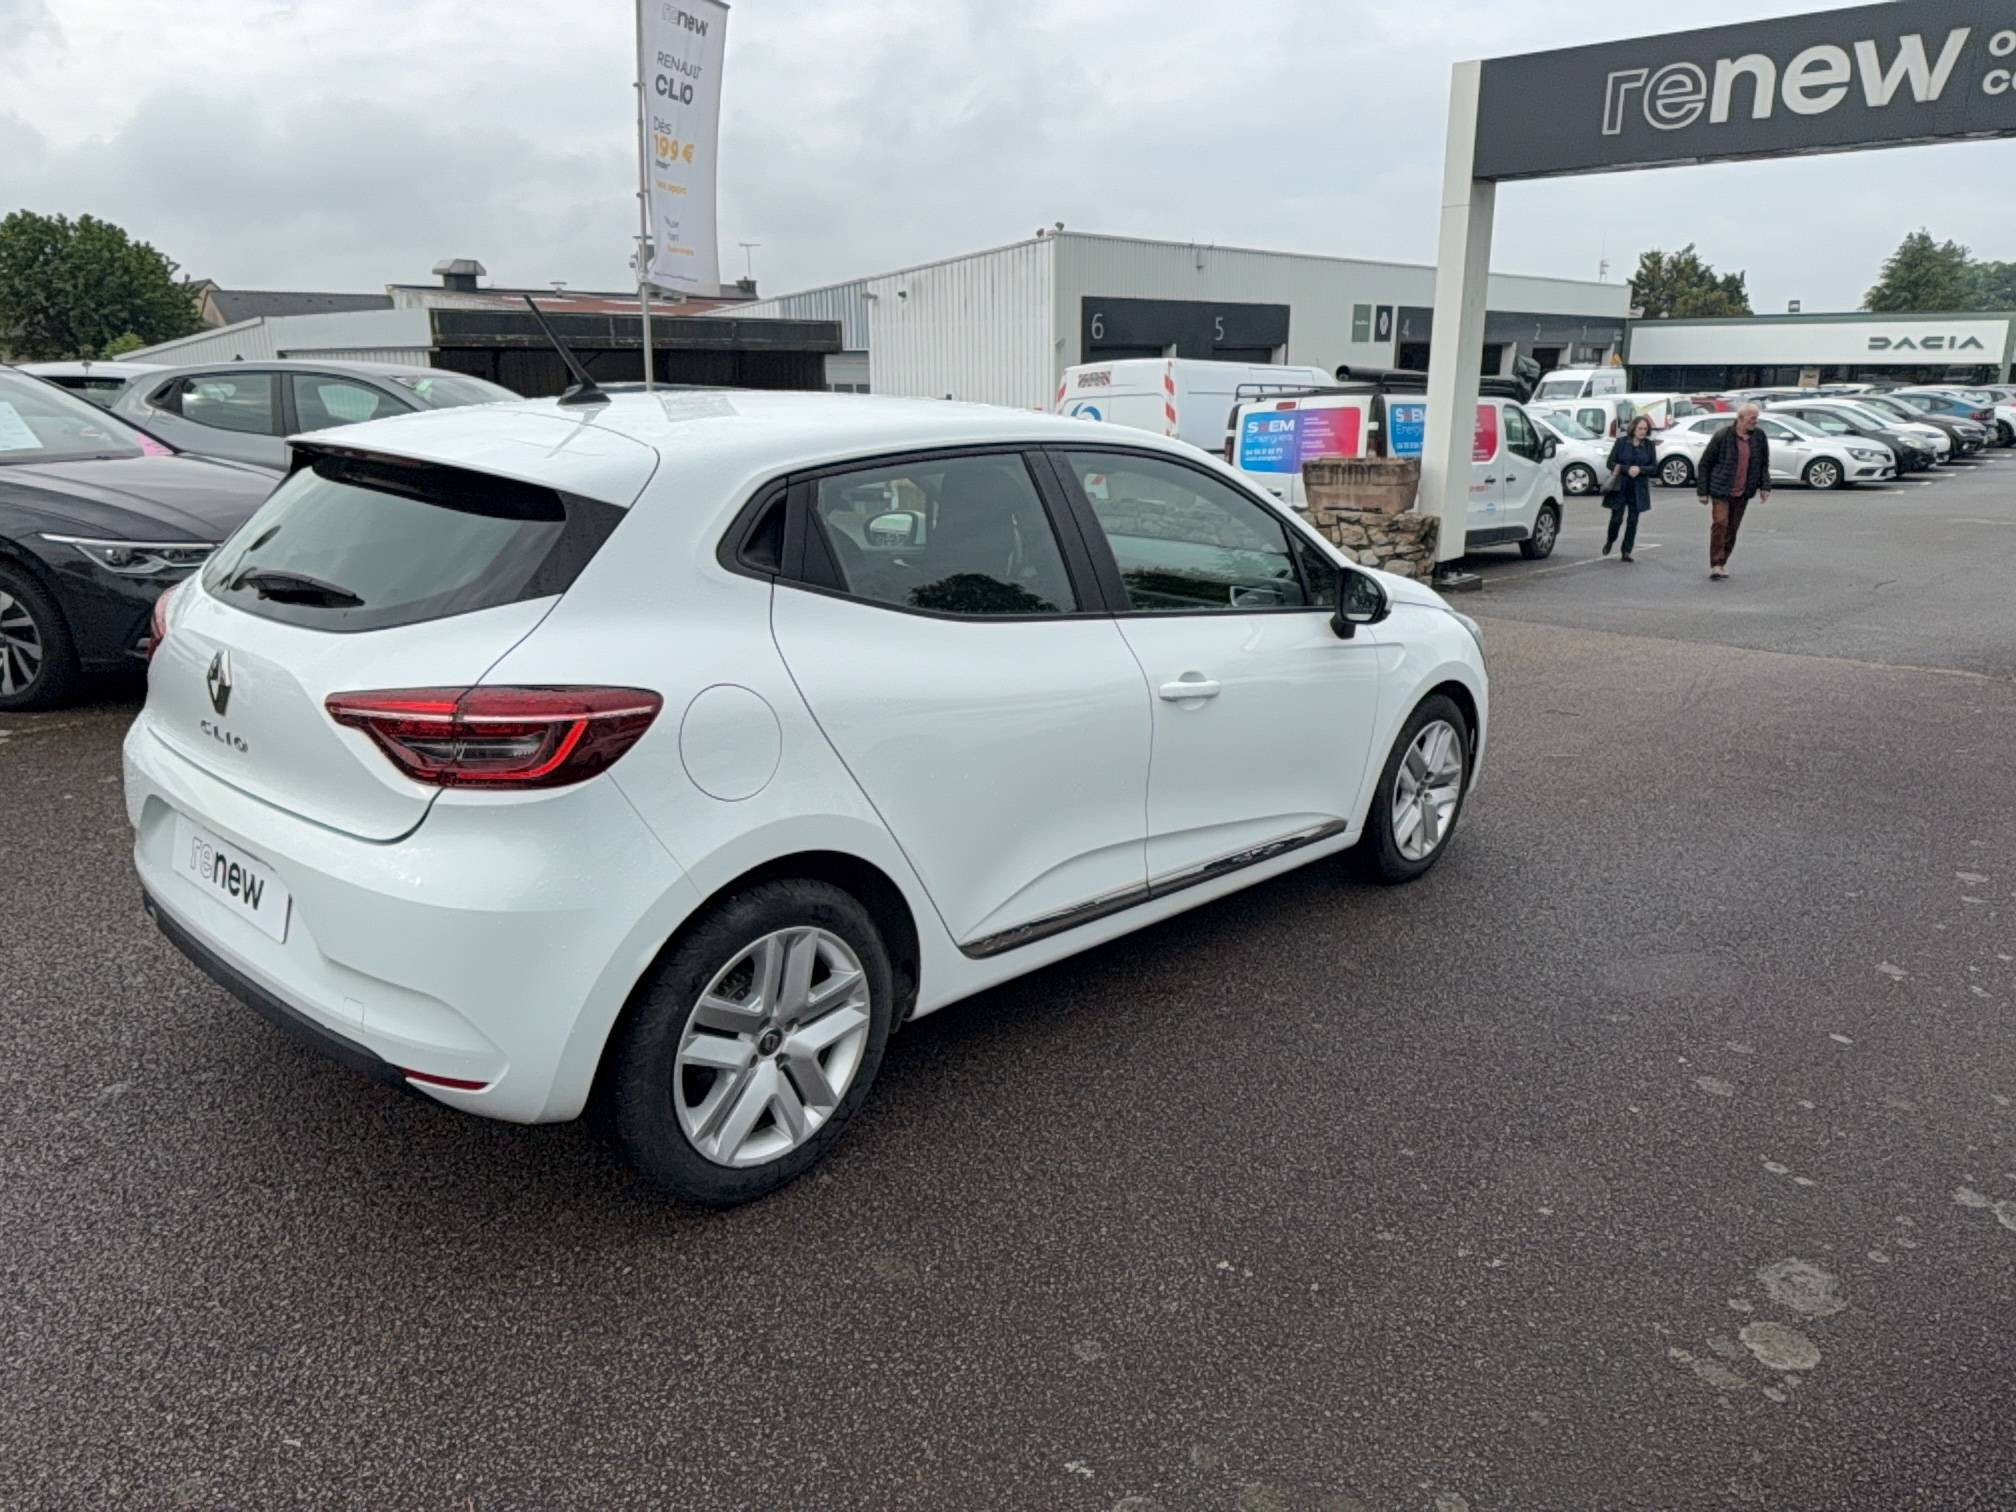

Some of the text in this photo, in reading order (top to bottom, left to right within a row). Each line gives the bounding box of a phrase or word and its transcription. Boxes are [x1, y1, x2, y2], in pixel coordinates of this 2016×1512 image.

[662, 3, 708, 37] renew
[655, 74, 693, 105] CLIO
[1602, 27, 1970, 135] renew
[1982, 69, 2016, 96] c
[653, 134, 678, 160] 199
[1091, 313, 1105, 340] 6
[1214, 317, 1225, 341] 5
[1401, 319, 1410, 338] 4
[1868, 336, 1984, 350] DACIA
[200, 720, 248, 752] CLIO
[190, 836, 264, 910] renew
